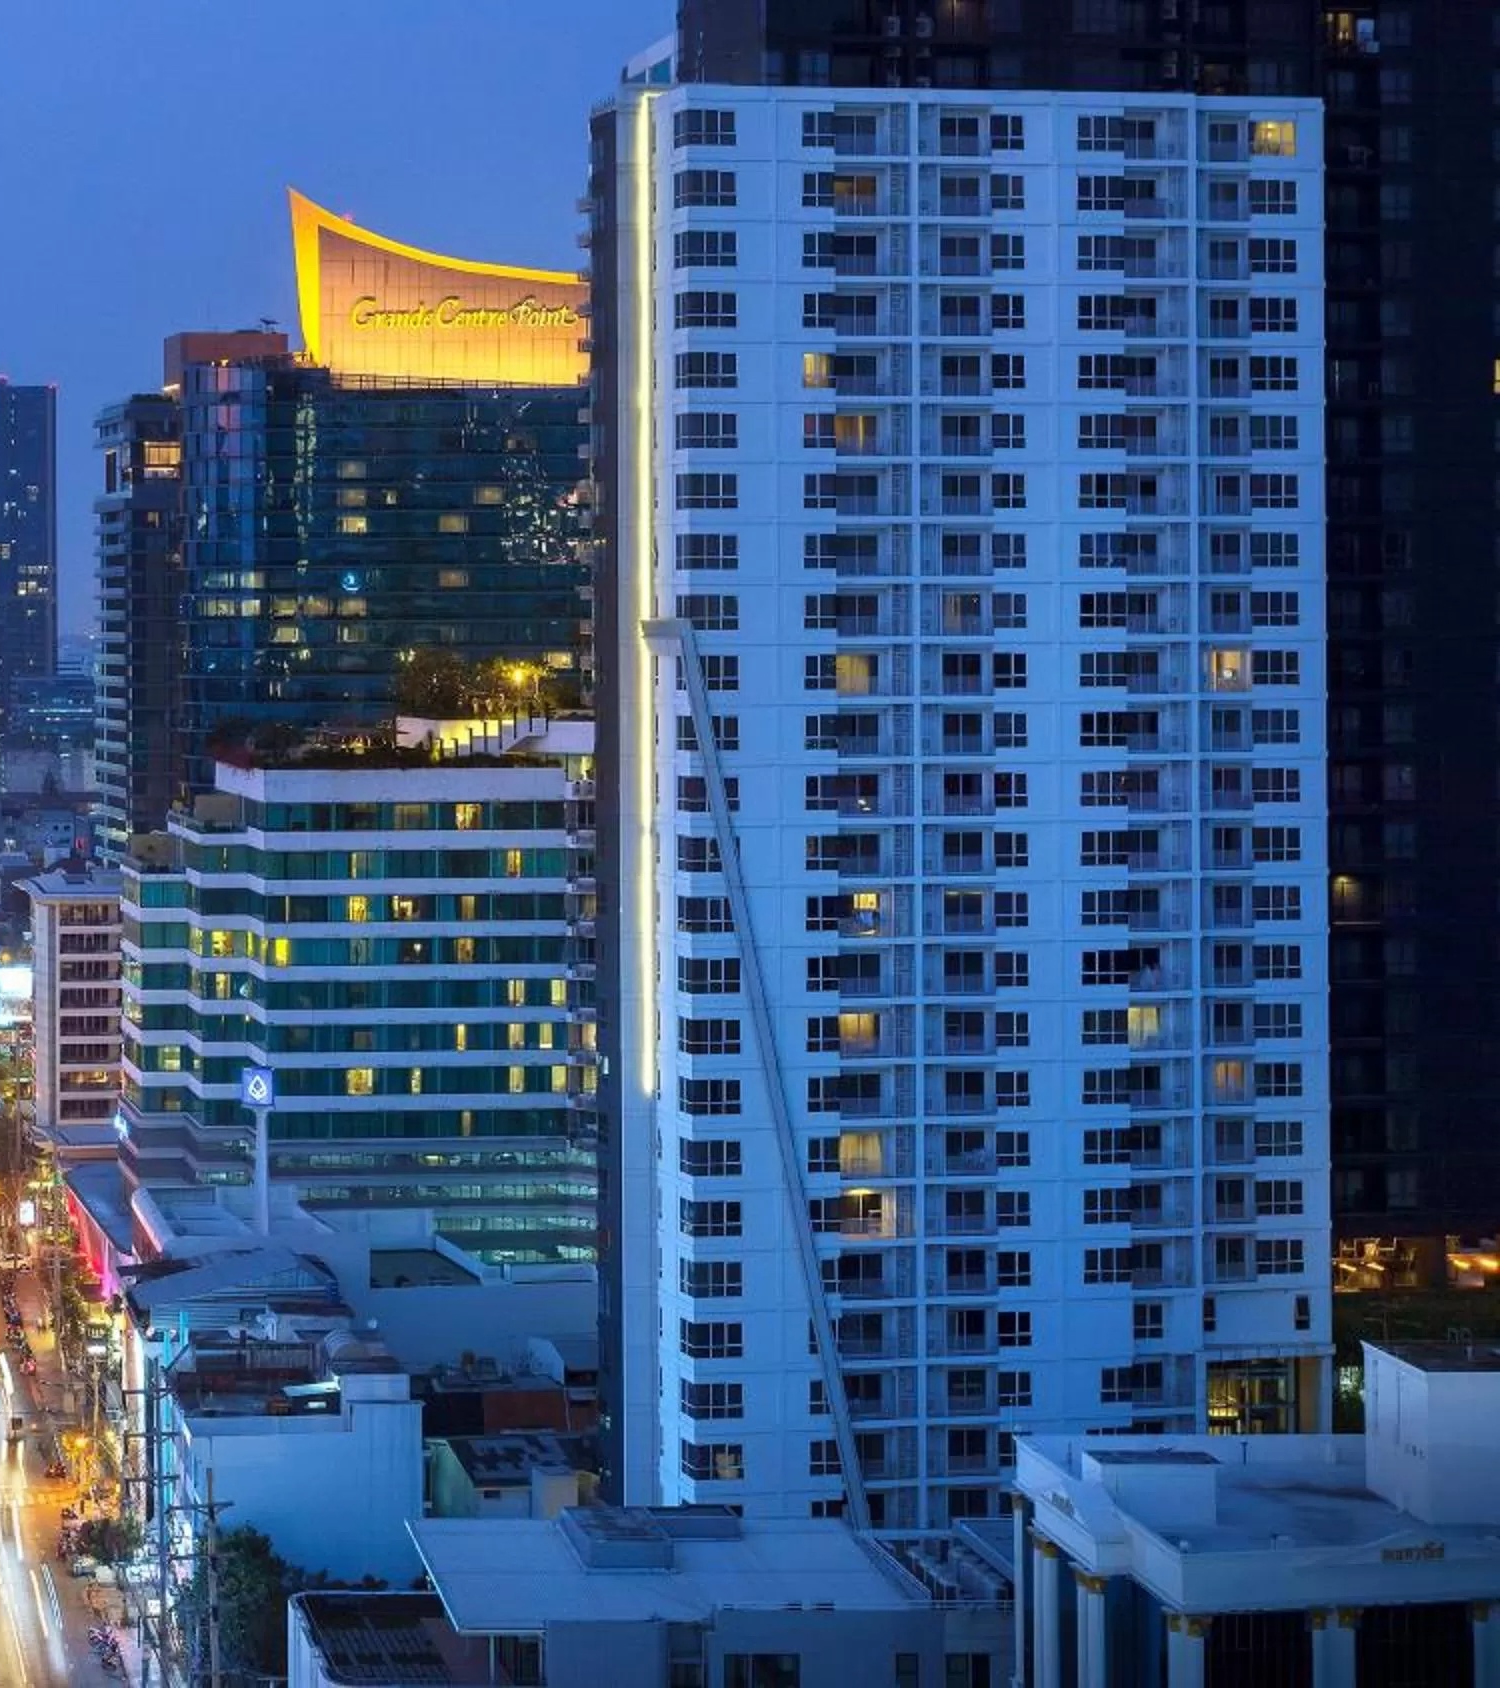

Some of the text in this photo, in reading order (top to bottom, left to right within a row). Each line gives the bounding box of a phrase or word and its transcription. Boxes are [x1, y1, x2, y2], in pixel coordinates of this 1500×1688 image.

[352, 295, 579, 330] Grande Centre Point
